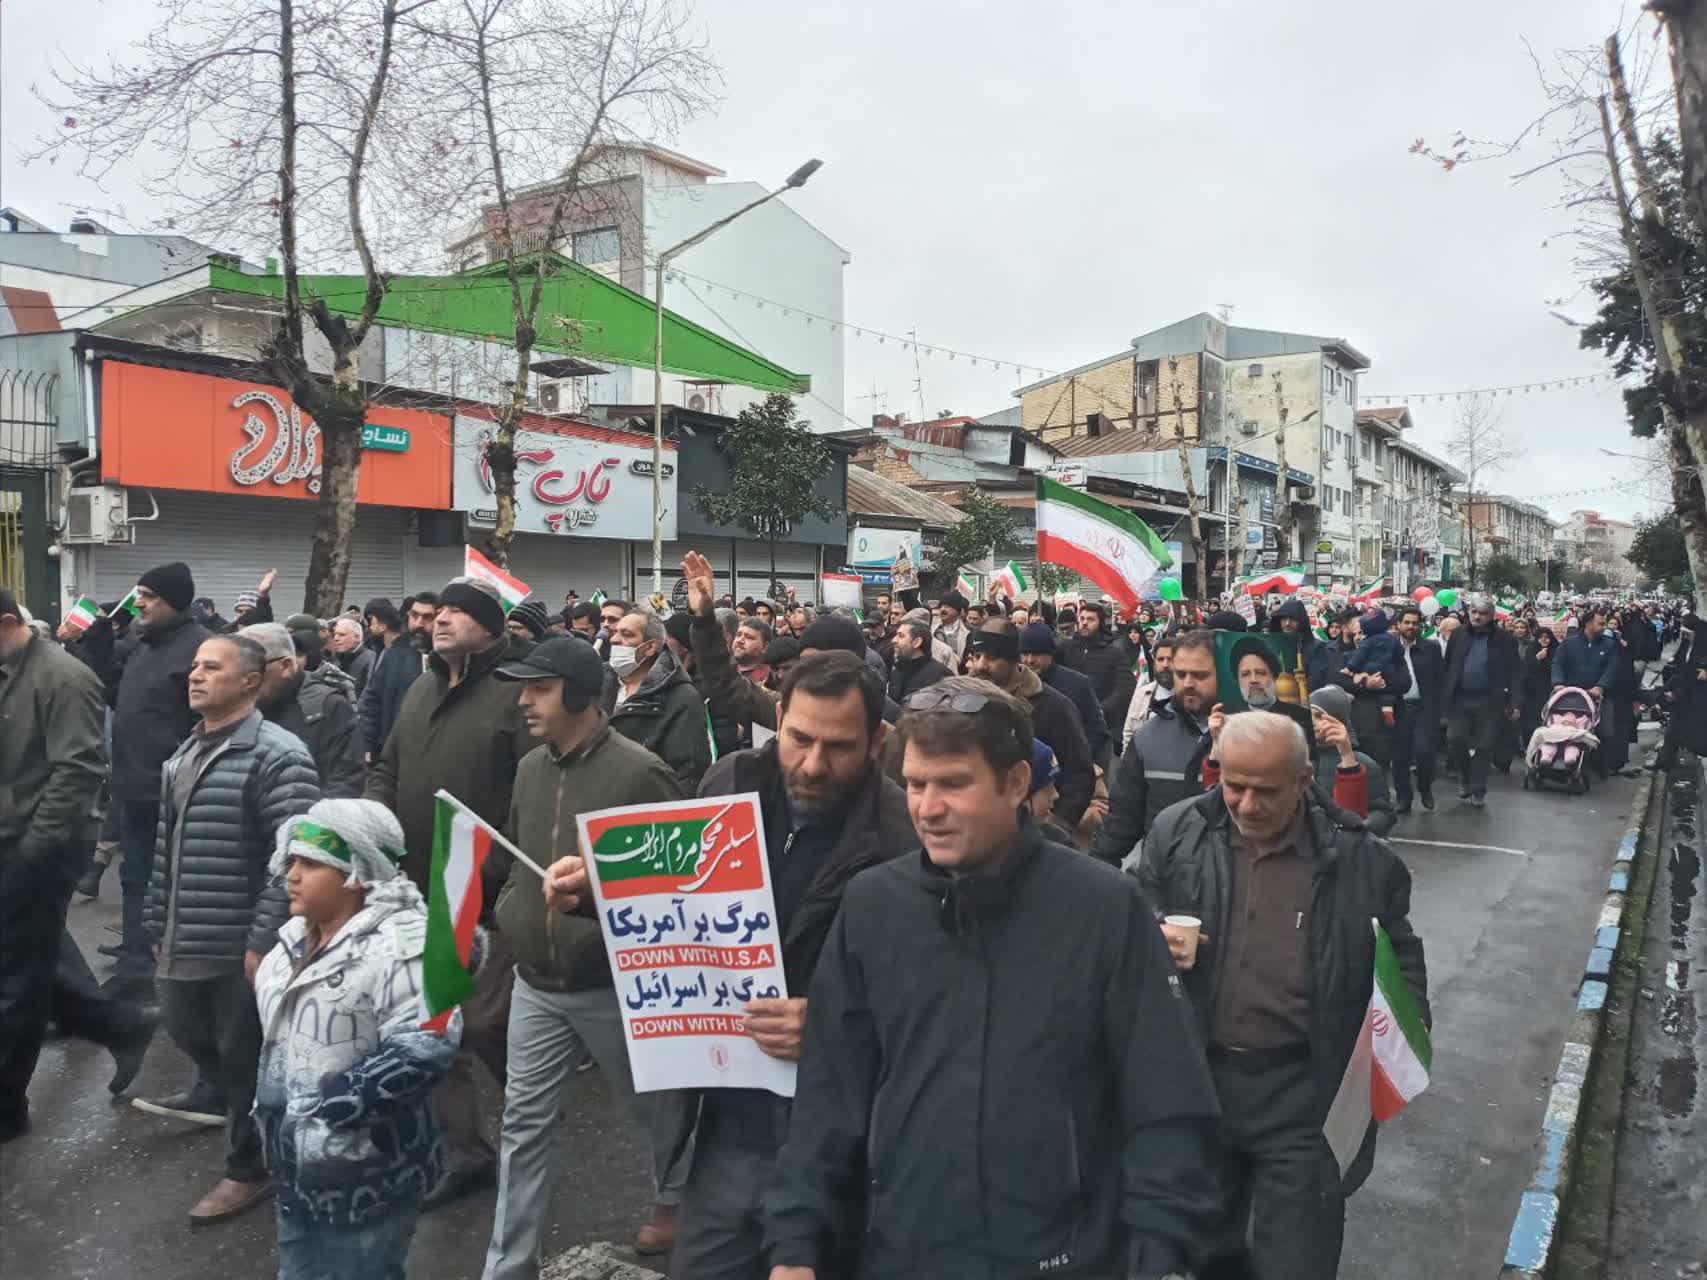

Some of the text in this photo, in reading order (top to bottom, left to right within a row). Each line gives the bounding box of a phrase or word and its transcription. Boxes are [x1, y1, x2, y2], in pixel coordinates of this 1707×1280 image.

[593, 822, 665, 869] ایران
[666, 826, 698, 875] مردم
[607, 898, 770, 943] مرگ بر آمریکا
[618, 947, 772, 968] DOWN WITH U.S.A
[626, 970, 707, 1010] اسرائیل
[712, 981, 731, 1007] بر
[632, 1019, 683, 1036] DOWN
[687, 1018, 727, 1032] WITH
